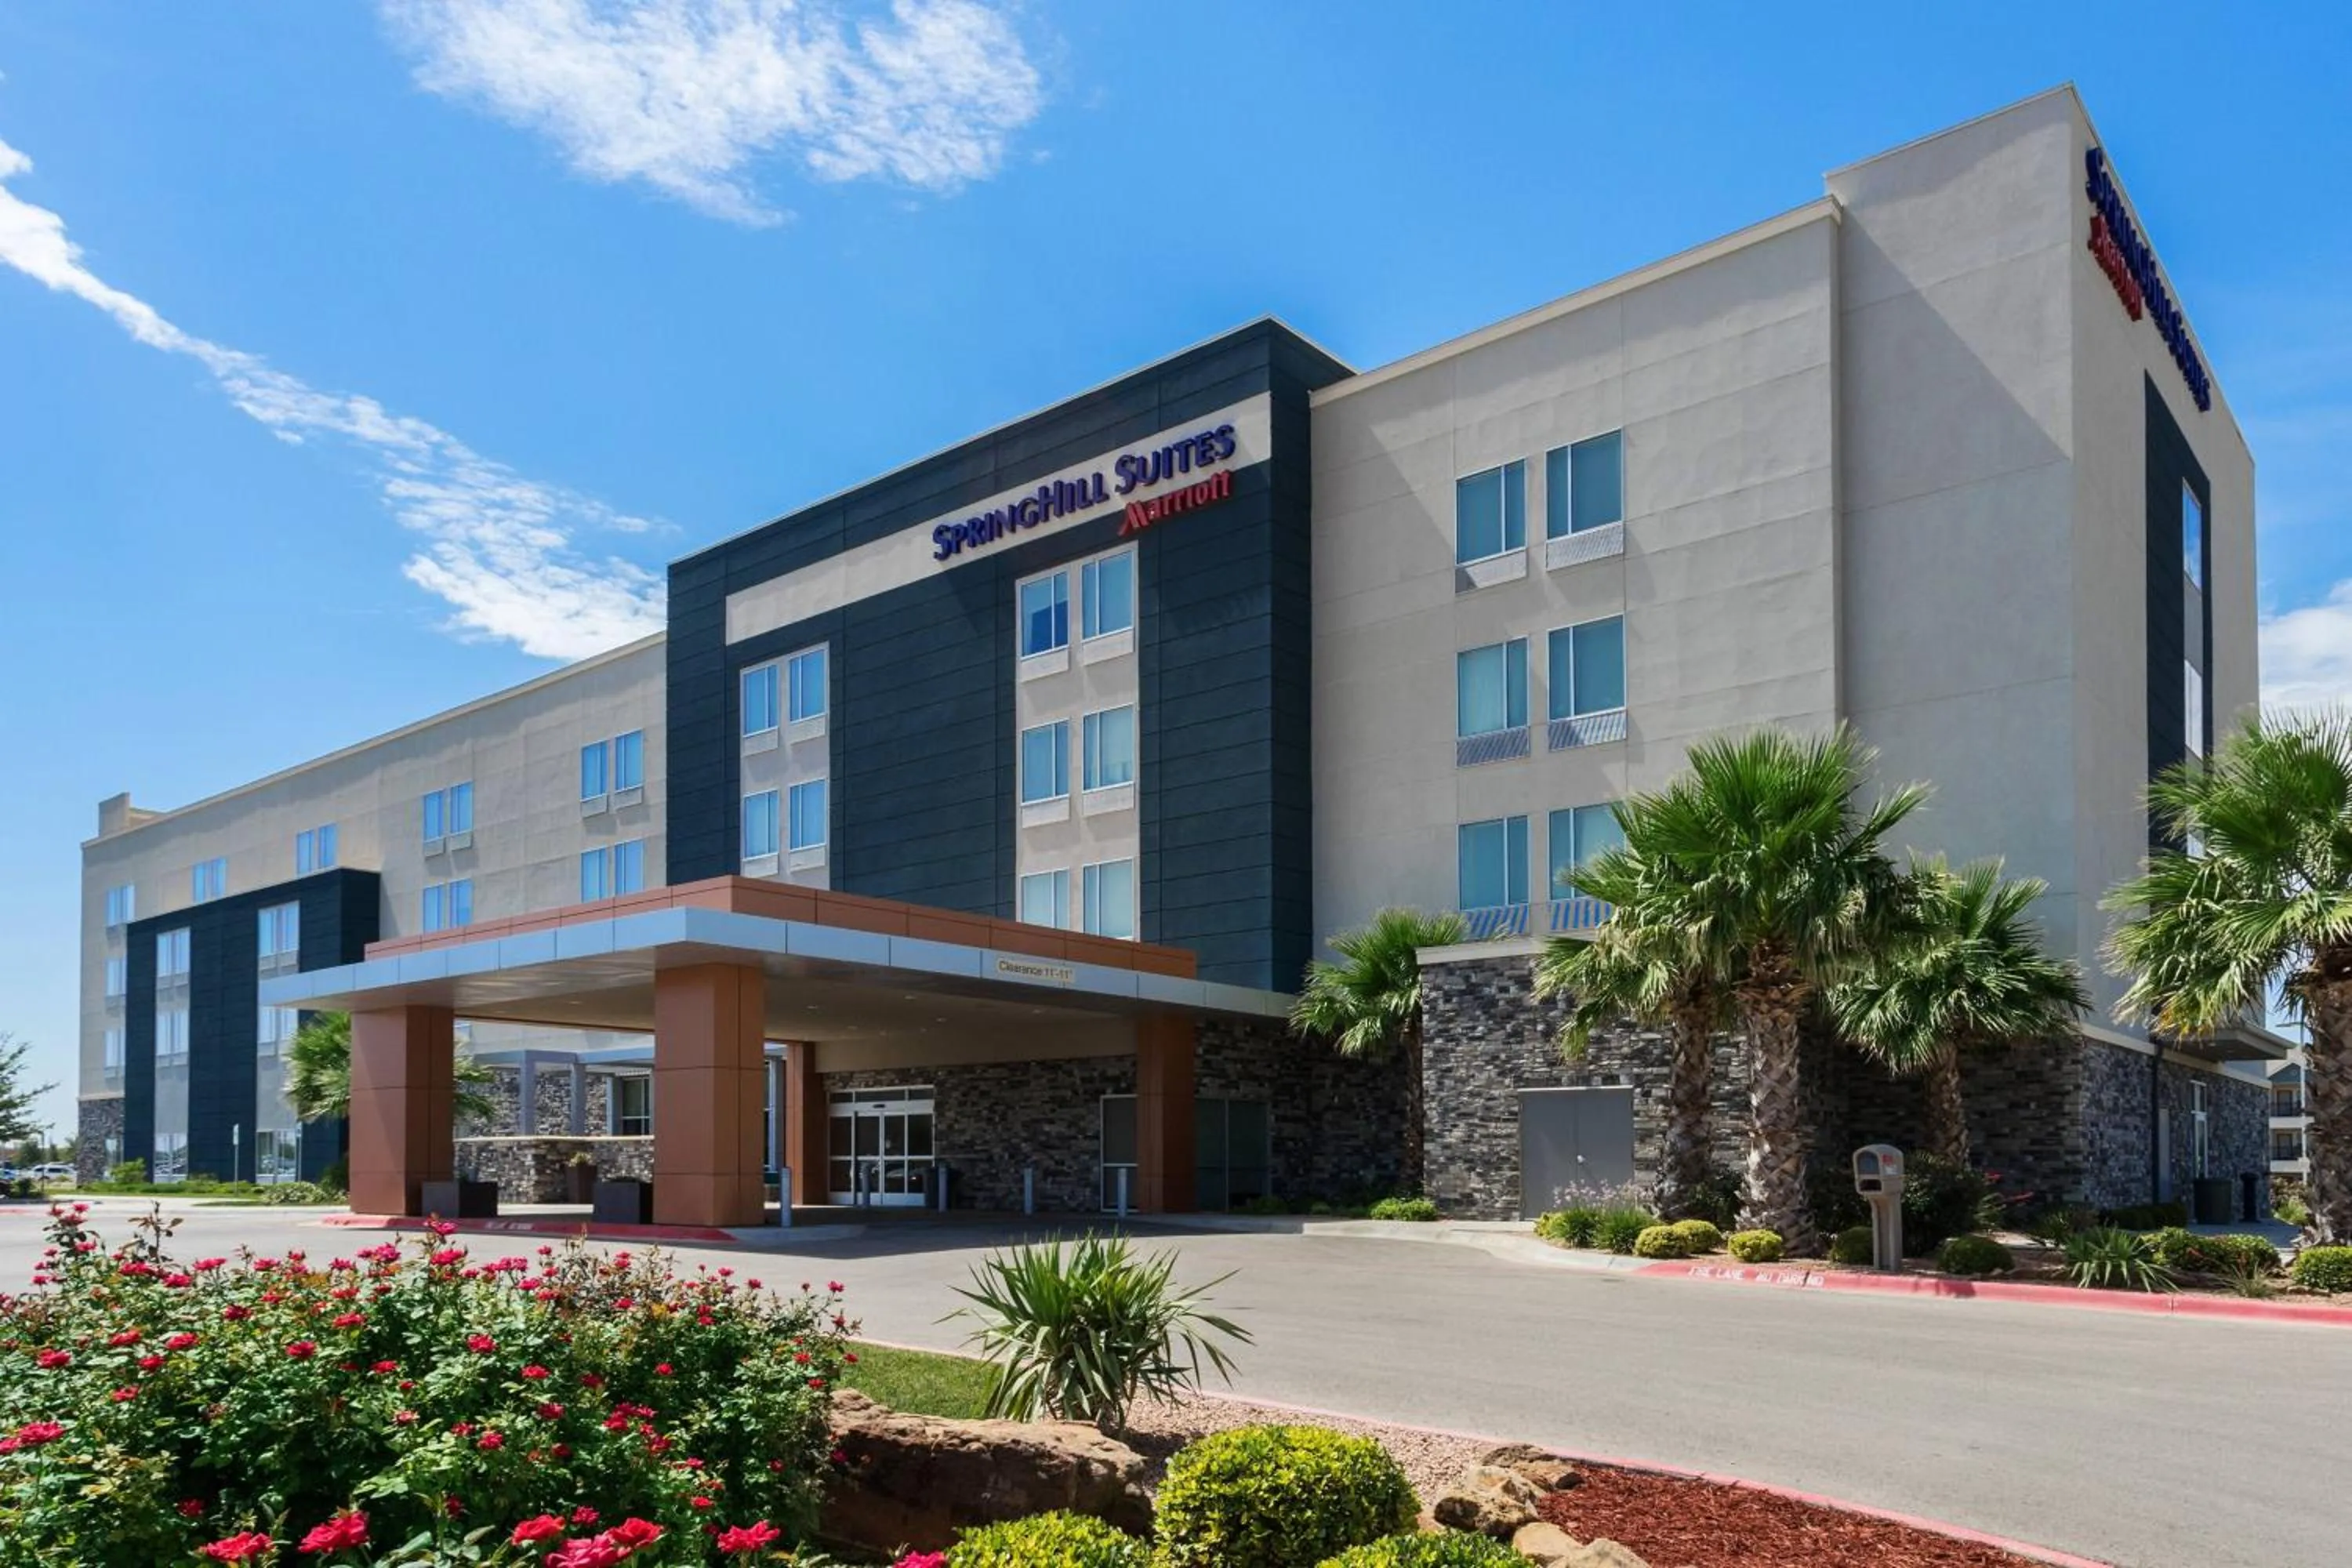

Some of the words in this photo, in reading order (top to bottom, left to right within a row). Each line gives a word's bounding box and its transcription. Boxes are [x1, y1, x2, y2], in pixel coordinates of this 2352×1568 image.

[932, 471, 1109, 561] SPRINGHILL
[1114, 423, 1236, 496] SUITES
[1118, 469, 1235, 536] Marriott
[999, 960, 1042, 976] Clearance
